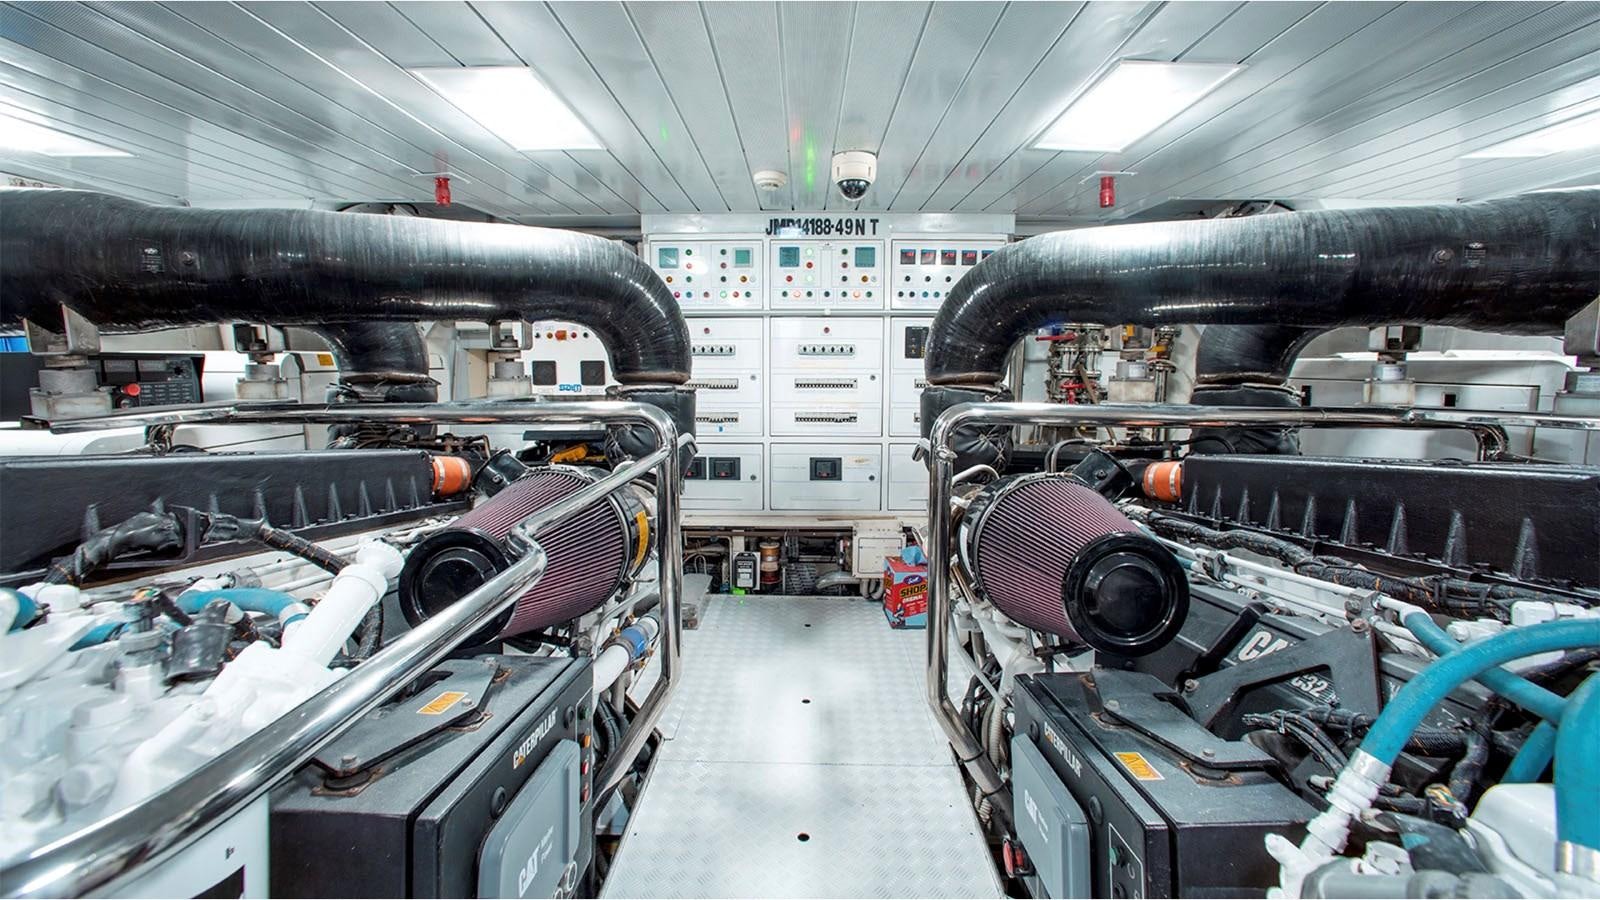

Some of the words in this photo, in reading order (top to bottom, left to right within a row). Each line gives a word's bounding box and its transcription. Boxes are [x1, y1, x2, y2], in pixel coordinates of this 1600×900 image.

[900, 585, 926, 597] SHOP
[1239, 631, 1288, 661] CA
[513, 707, 557, 769] CATERPILLAR
[1044, 721, 1081, 778] CATERPILLAR
[518, 845, 540, 898] CAT
